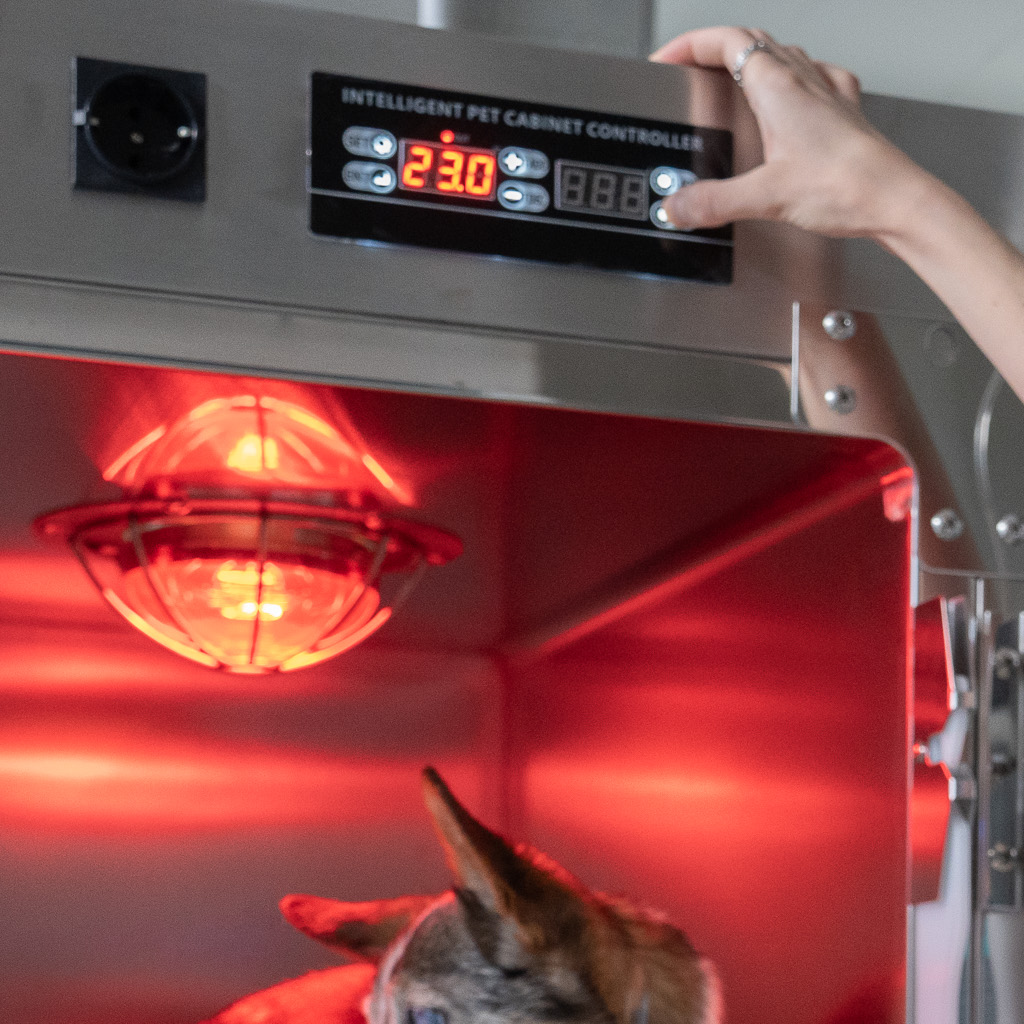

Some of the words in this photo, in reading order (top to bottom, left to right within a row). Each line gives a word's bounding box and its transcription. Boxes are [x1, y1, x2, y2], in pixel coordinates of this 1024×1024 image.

[342, 87, 463, 119] INTELLIGENT
[466, 103, 501, 124] PET
[503, 108, 583, 136] CABINET
[586, 121, 704, 151] CONTROLLER
[402, 145, 496, 196] 23.0
